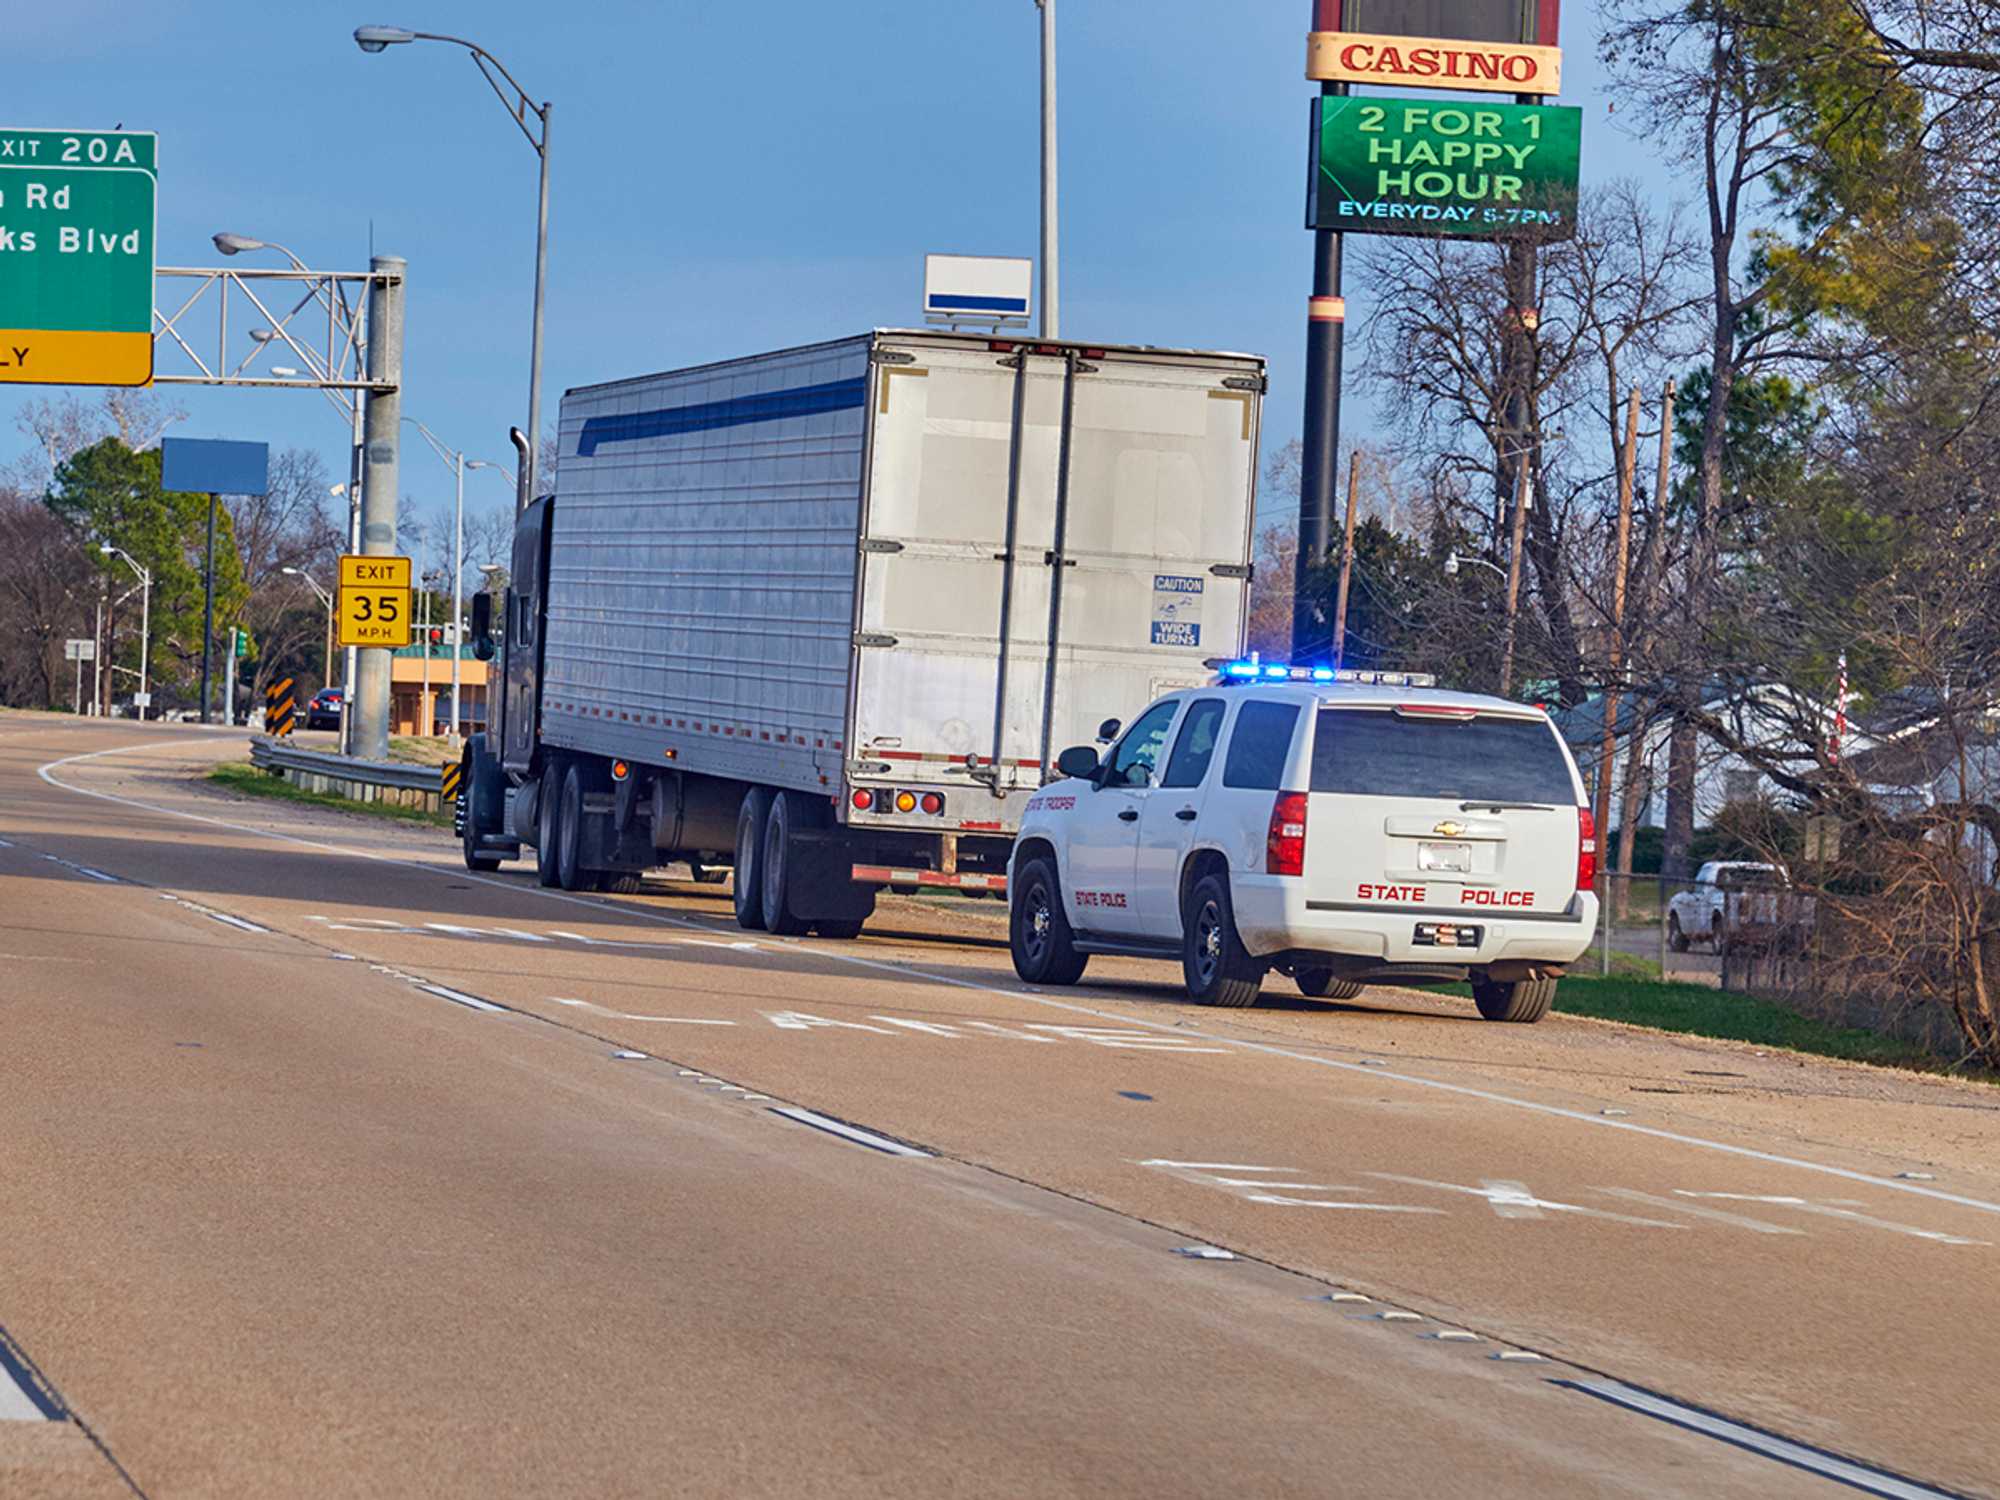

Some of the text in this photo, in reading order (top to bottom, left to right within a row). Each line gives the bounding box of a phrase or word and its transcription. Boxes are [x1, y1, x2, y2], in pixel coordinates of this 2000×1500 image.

[1340, 44, 1538, 82] CASINO
[1358, 106, 1540, 139] 2 FOR 1
[61, 137, 137, 163] 20A
[1368, 138, 1537, 170] HAPPY
[27, 183, 70, 210] Rd
[1377, 170, 1524, 202] HOUR
[1338, 200, 1476, 223] EVERYDAY
[59, 226, 140, 255] Blvd
[356, 565, 395, 579] EXIT
[1156, 577, 1202, 592] CAUTION
[353, 596, 398, 622] 35
[1154, 632, 1196, 645] TURNS
[1160, 623, 1192, 634] WIDE
[1075, 891, 1127, 908] STATE POLICE
[1357, 883, 1535, 906] STATE POLICE
